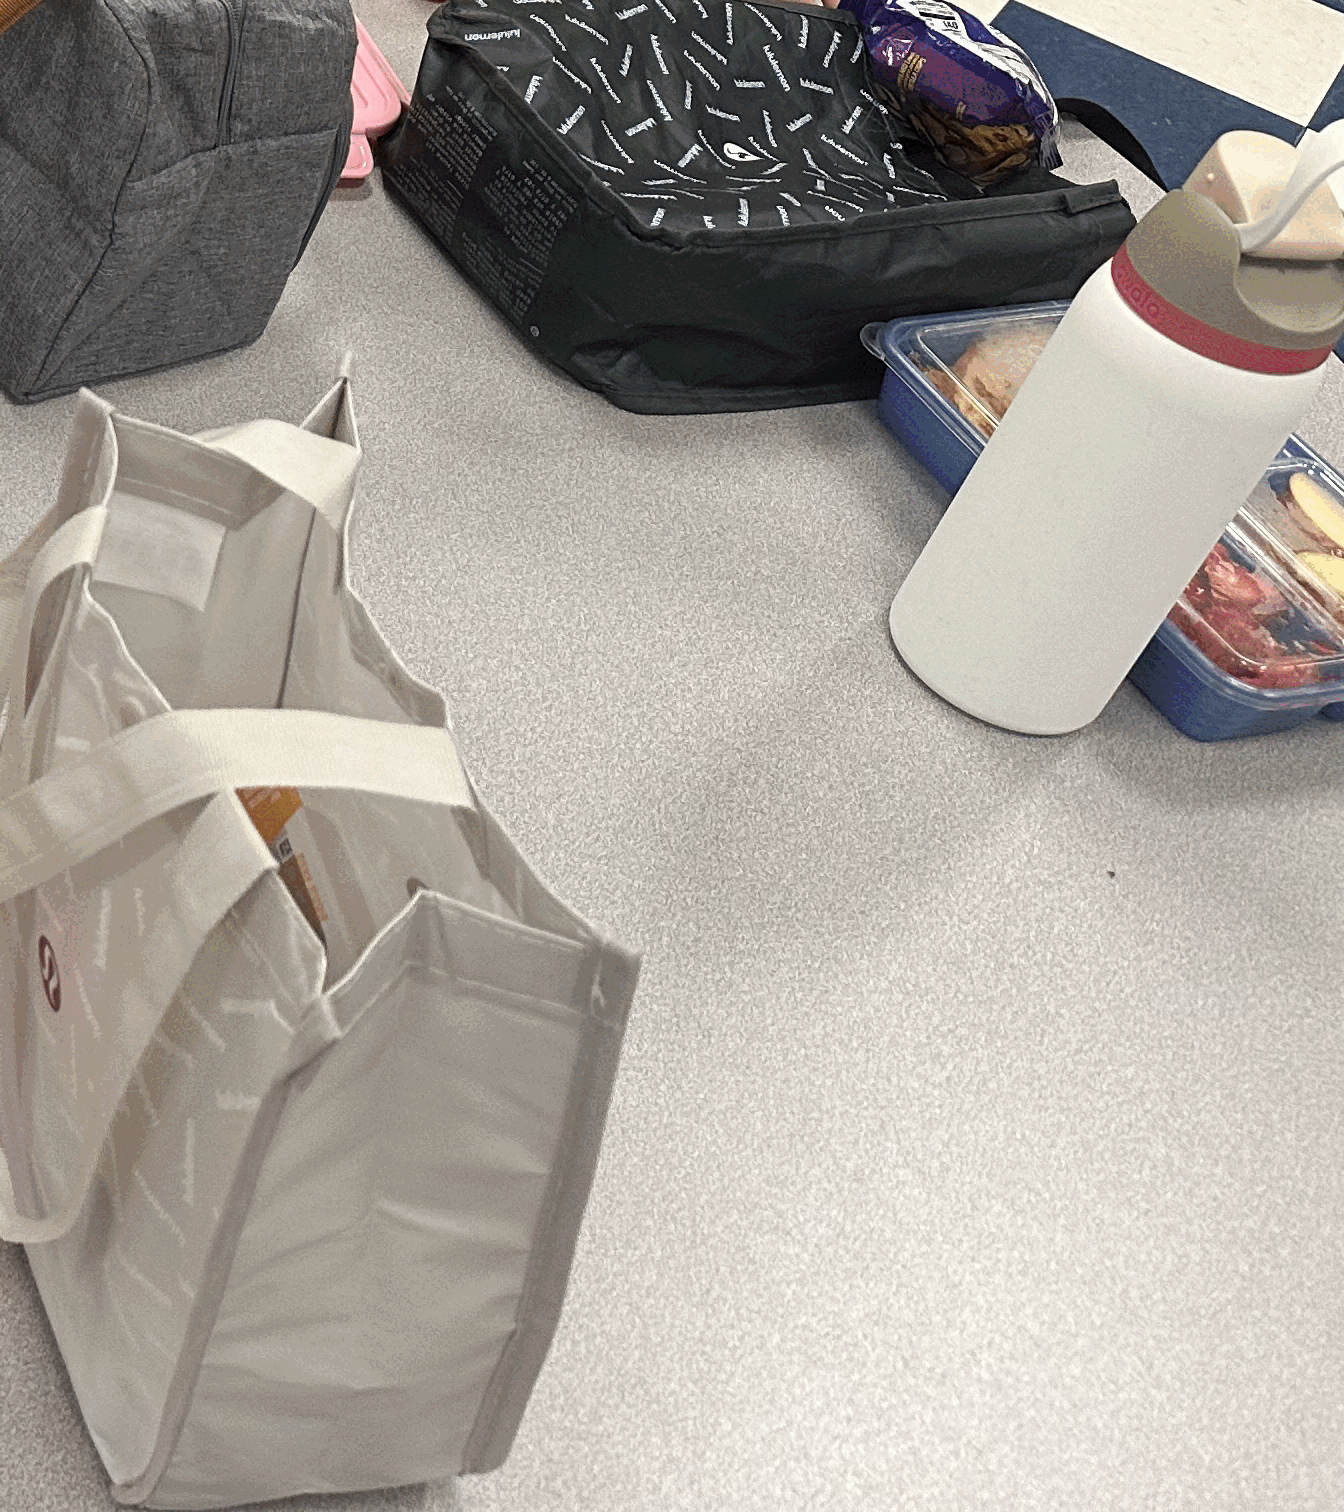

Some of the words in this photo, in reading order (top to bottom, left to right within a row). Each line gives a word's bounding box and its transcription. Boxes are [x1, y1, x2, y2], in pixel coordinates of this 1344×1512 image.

[464, 29, 521, 42] lululemon
[683, 49, 721, 91] lululemon
[762, 44, 791, 92] lululemon
[556, 104, 586, 135] lululemon
[820, 133, 869, 166] lululemon
